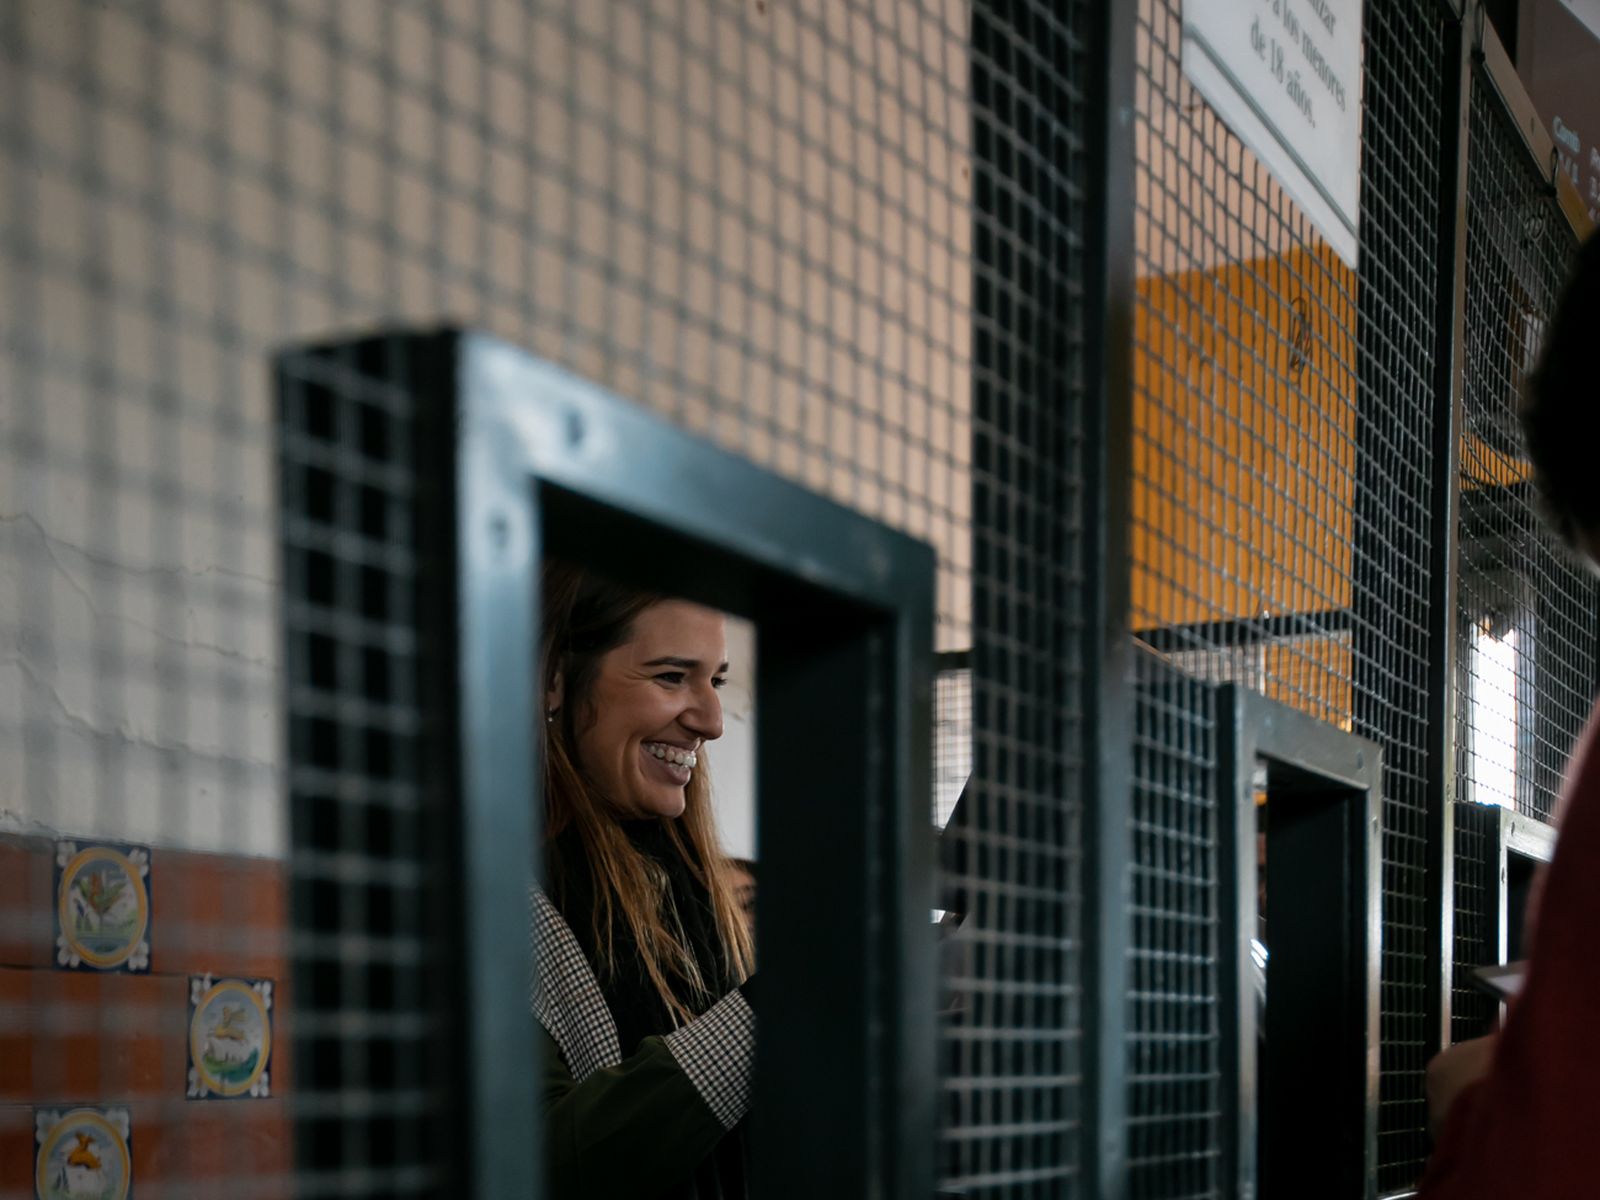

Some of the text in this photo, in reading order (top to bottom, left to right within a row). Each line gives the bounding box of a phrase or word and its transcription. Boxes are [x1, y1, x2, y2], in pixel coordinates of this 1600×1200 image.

[1251, 15, 1316, 128] de 18 años.
[1302, 31, 1345, 111] menores
